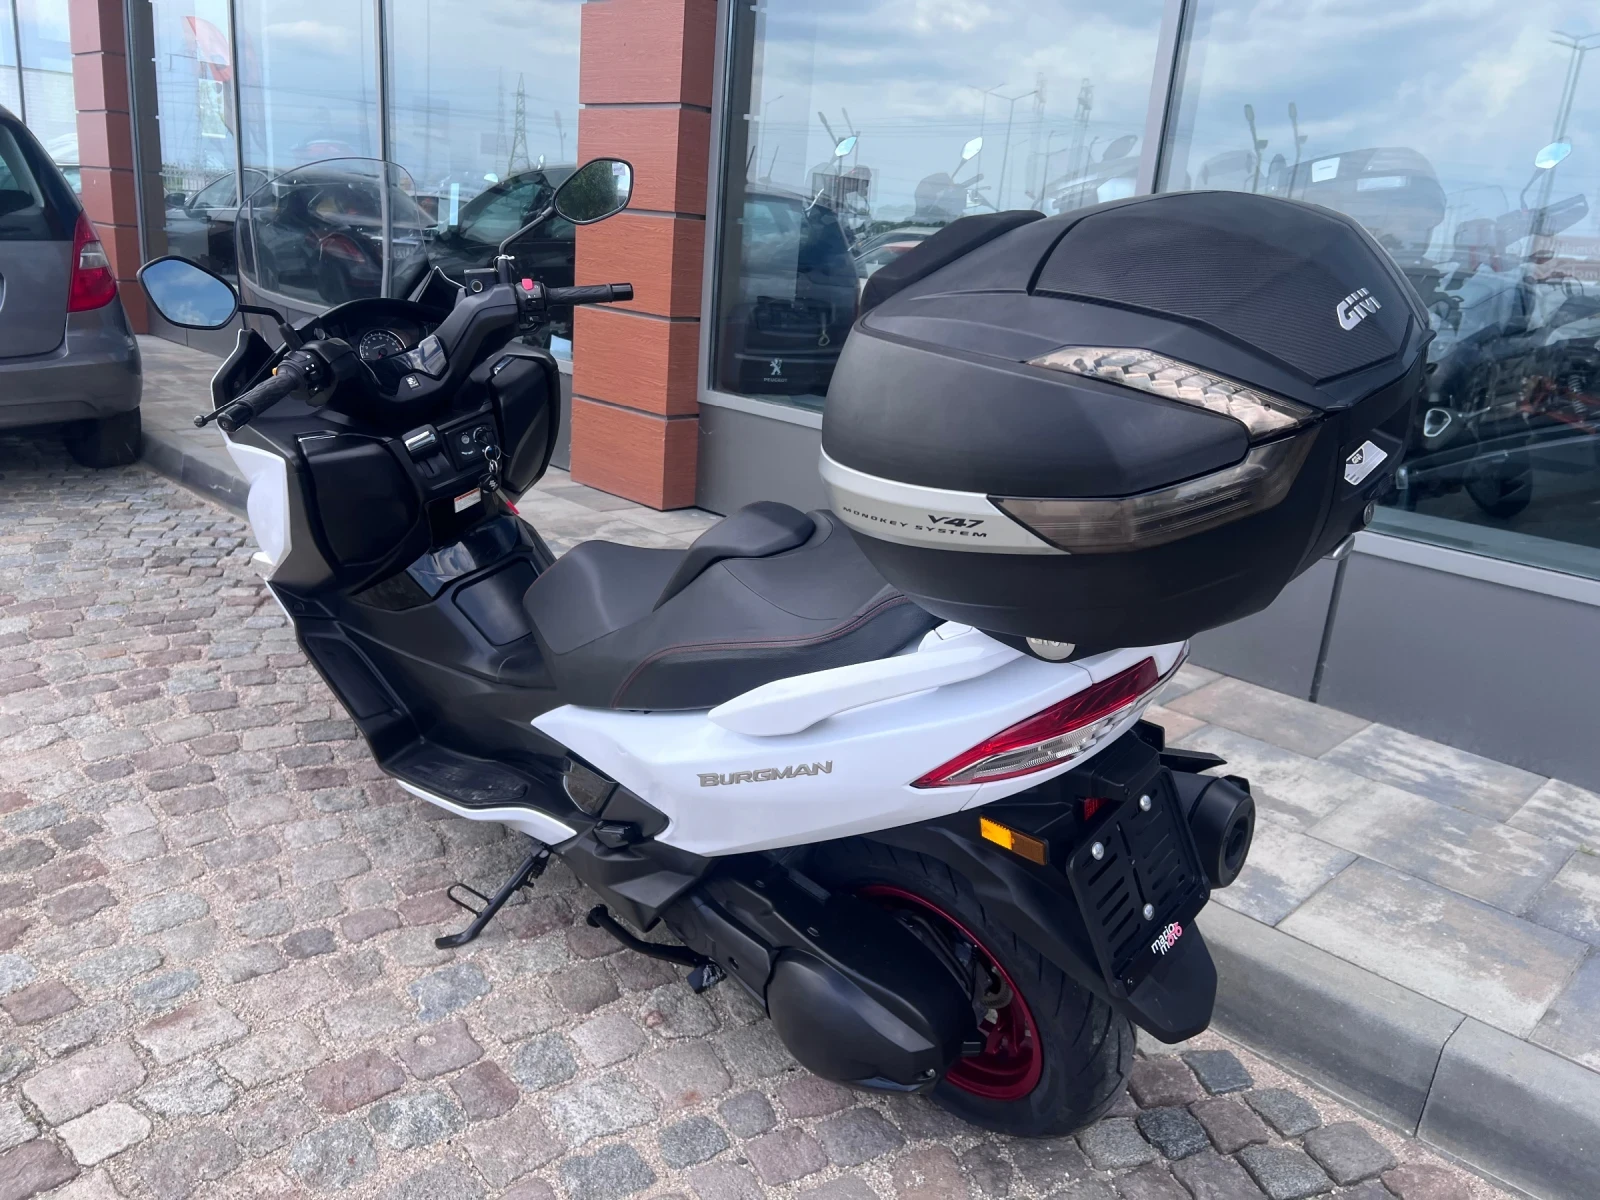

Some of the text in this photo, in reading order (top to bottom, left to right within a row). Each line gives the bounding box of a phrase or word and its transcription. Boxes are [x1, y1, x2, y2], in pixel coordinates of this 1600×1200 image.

[843, 506, 987, 538] MONOKEY SYSTEM
[928, 514, 984, 529] V47
[696, 760, 833, 787] BURGMAN
[1151, 923, 1175, 954] mario
